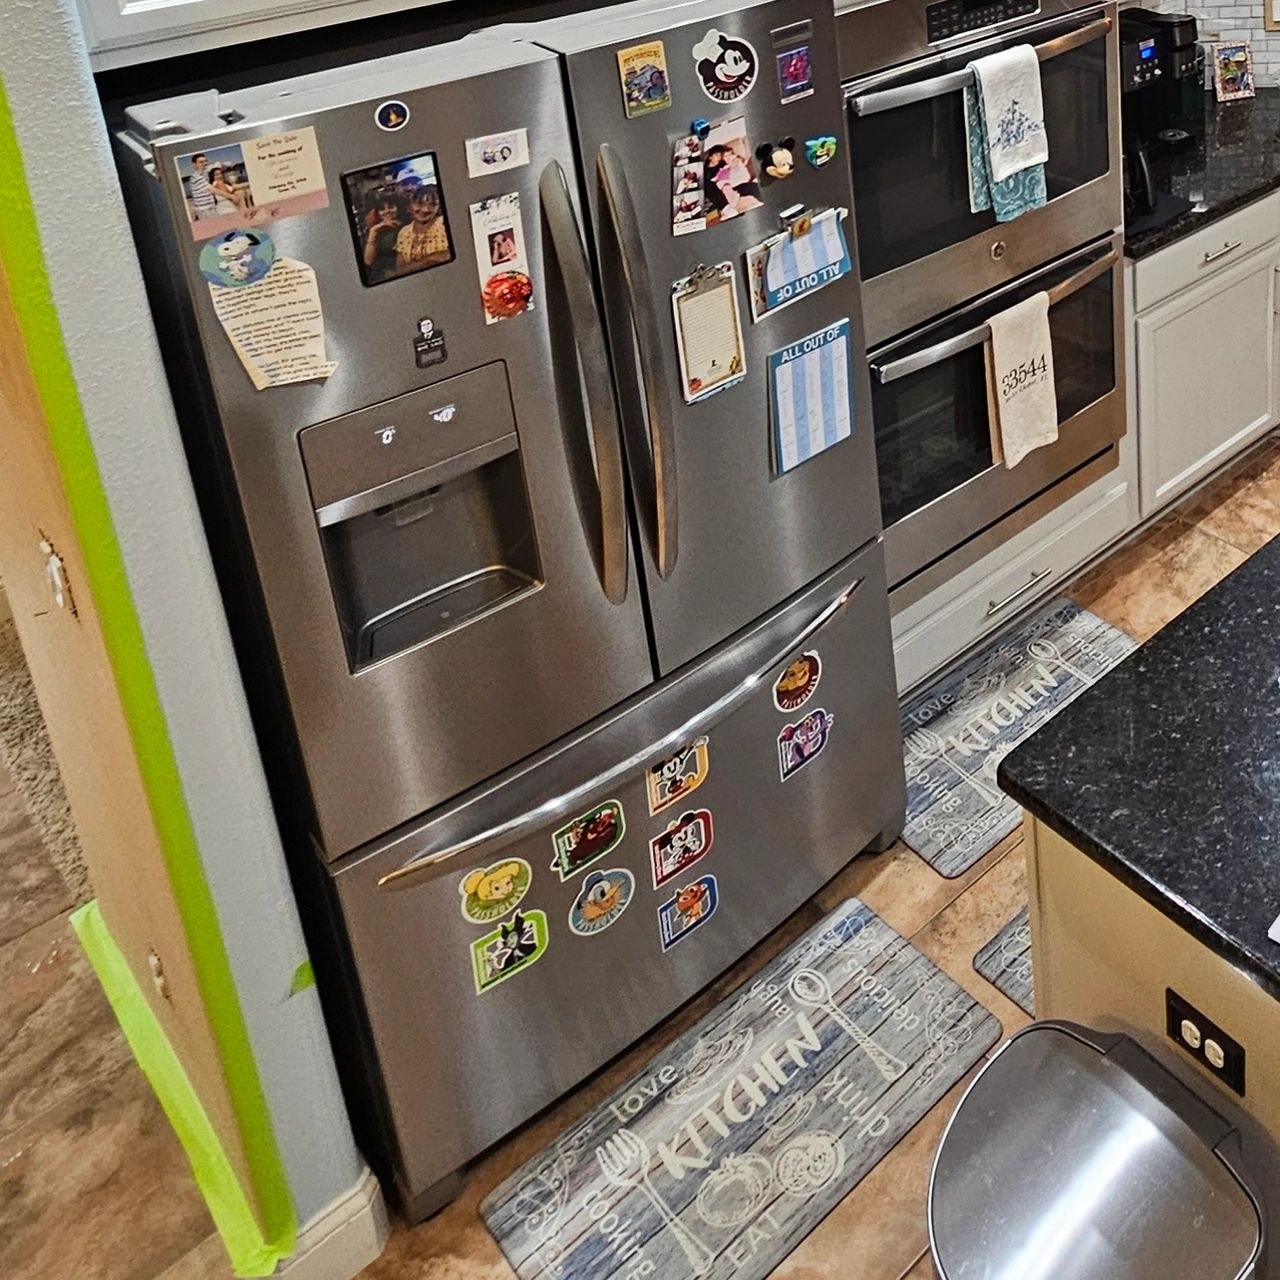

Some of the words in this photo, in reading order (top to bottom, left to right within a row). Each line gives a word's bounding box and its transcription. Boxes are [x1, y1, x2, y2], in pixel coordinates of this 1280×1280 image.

[705, 74, 753, 101] PASSHOLDER
[794, 272, 819, 294] OUT
[818, 260, 841, 281] ALL
[776, 284, 793, 302] OF
[781, 346, 803, 364] ALL
[803, 335, 827, 354] OUT
[826, 326, 841, 341] OF
[1002, 353, 1048, 397] 33544
[908, 692, 956, 727] love
[948, 662, 1059, 757] KITCHEN
[750, 977, 794, 1021] laugh
[841, 956, 922, 1033] delicious
[609, 1062, 680, 1124] love
[656, 1010, 823, 1180] KITCHEN
[820, 1067, 892, 1140] drink
[580, 1189, 658, 1280] cooking
[725, 1207, 788, 1270] EAT
